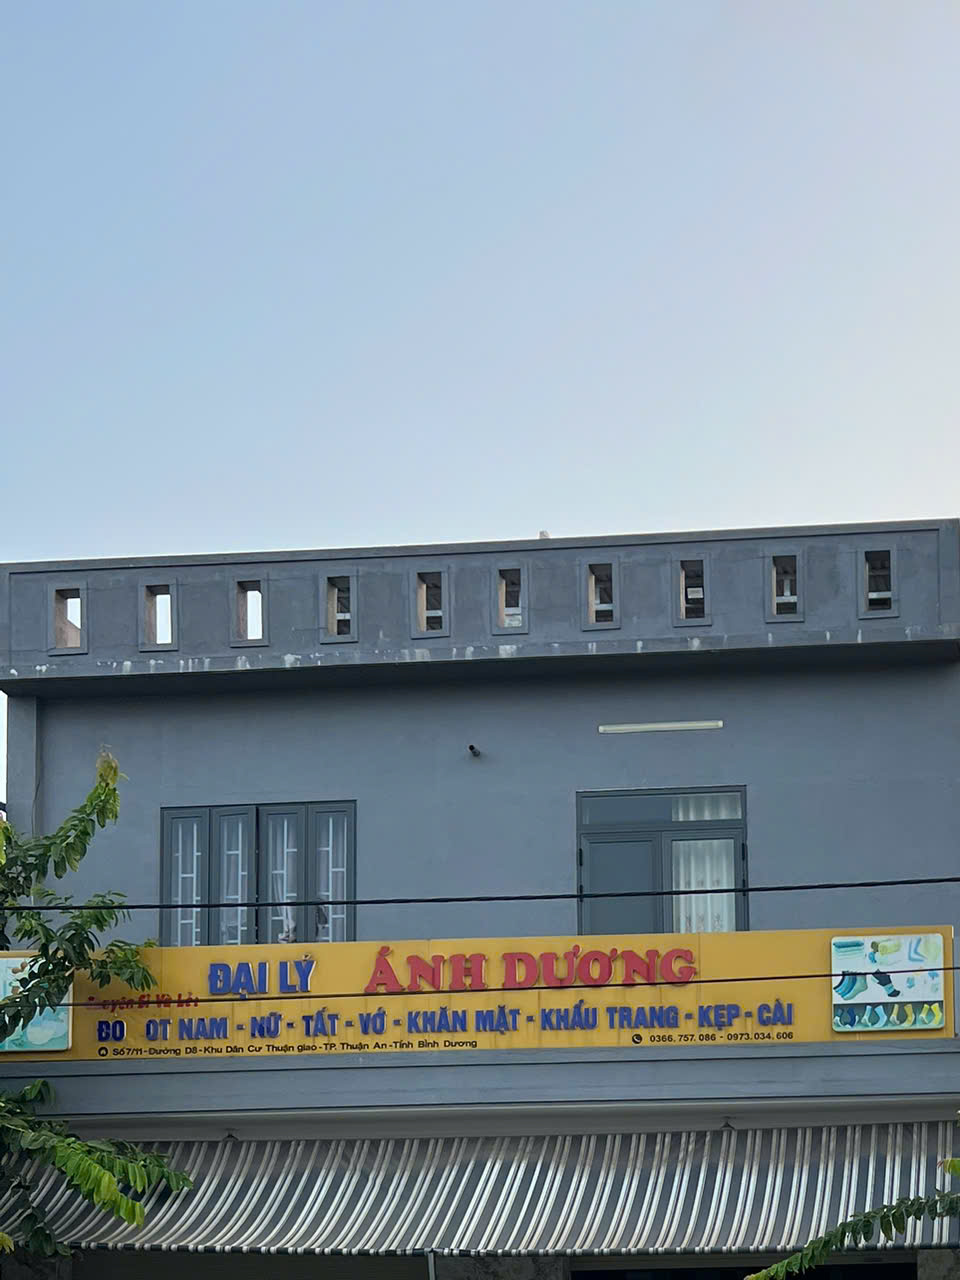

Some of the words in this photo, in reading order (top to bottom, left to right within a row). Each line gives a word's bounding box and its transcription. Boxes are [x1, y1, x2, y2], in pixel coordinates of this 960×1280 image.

[208, 961, 268, 999] ĐẠI
[365, 946, 487, 993] ÁNH
[502, 944, 697, 989] DƯƠNG
[178, 1017, 229, 1041] NAM
[250, 1011, 284, 1039] NỮ
[301, 1006, 339, 1038] TẤT
[358, 1007, 387, 1035] VỚ
[407, 1006, 467, 1033] KHĂN
[475, 1005, 521, 1035] MẶT
[606, 1005, 680, 1030] TRANG
[698, 1004, 740, 1031] KẸP
[757, 998, 794, 1026] CÀI
[443, 1039, 478, 1049] Dương
